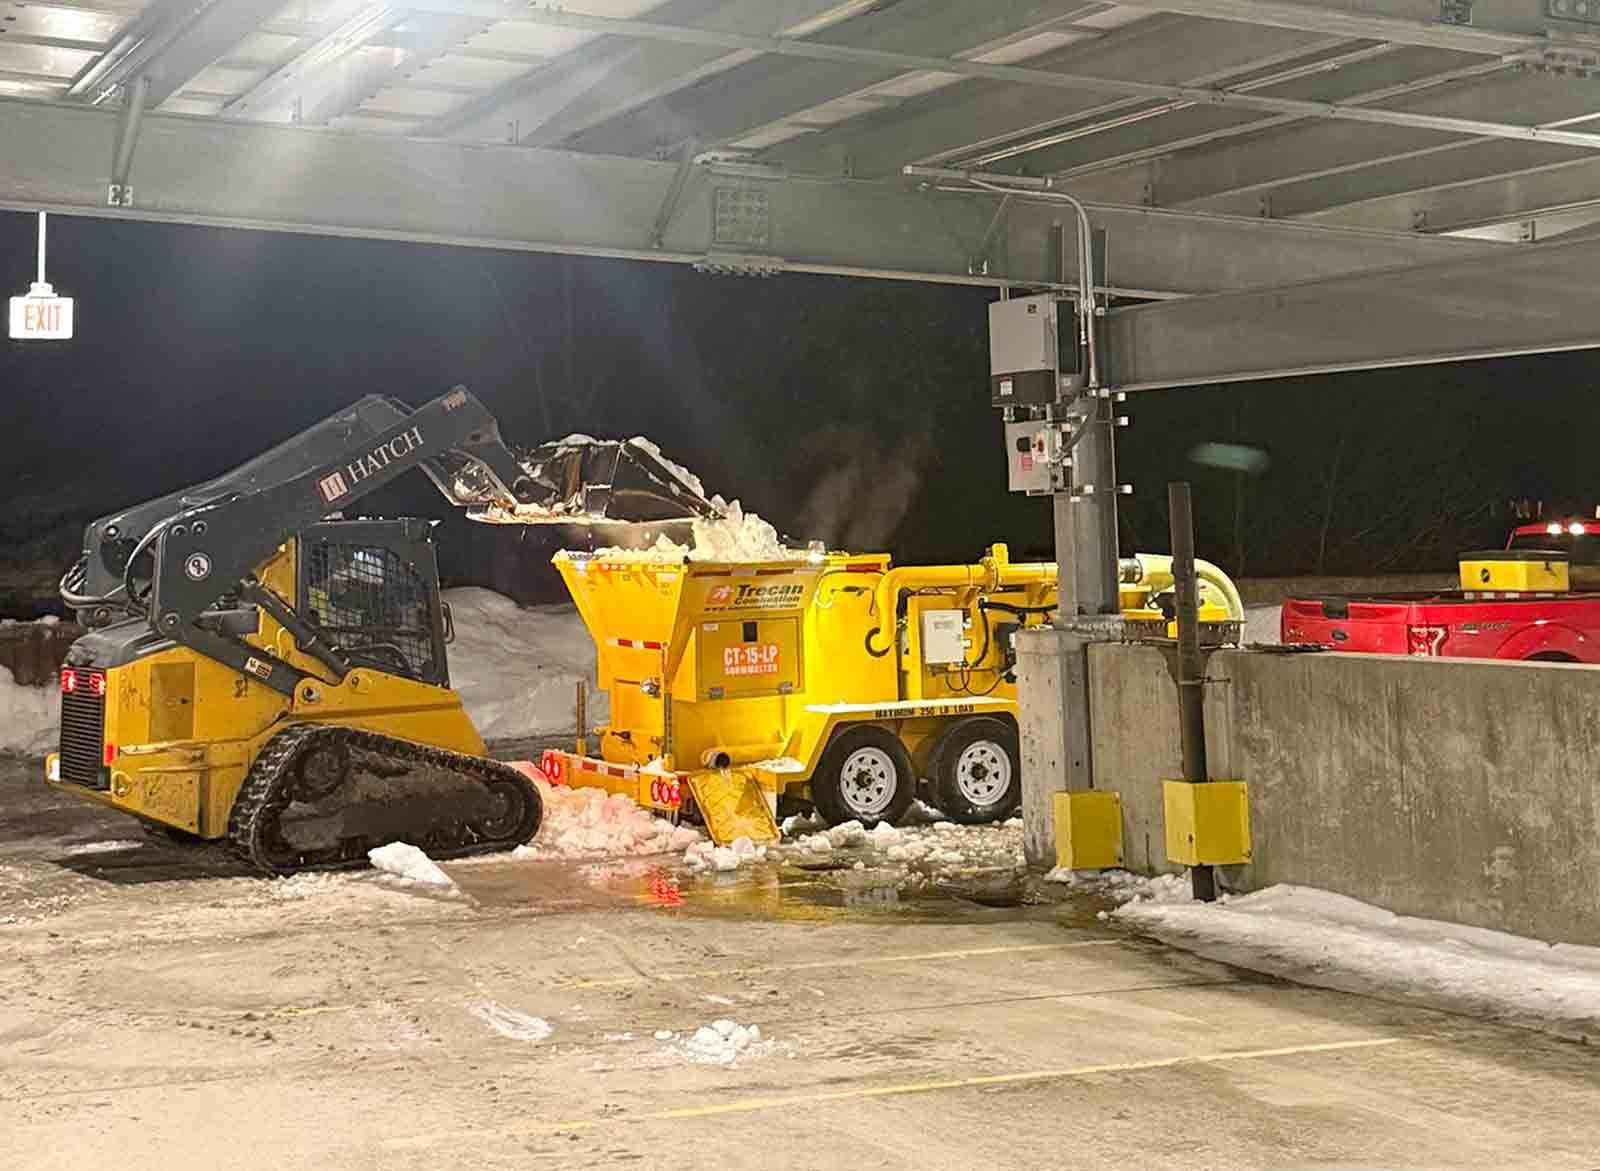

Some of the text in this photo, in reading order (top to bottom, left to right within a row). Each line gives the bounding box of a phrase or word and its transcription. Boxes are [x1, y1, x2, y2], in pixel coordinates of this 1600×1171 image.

[24, 304, 63, 331] EXIT
[346, 426, 424, 484] HATCH
[736, 584, 803, 597] Trecan
